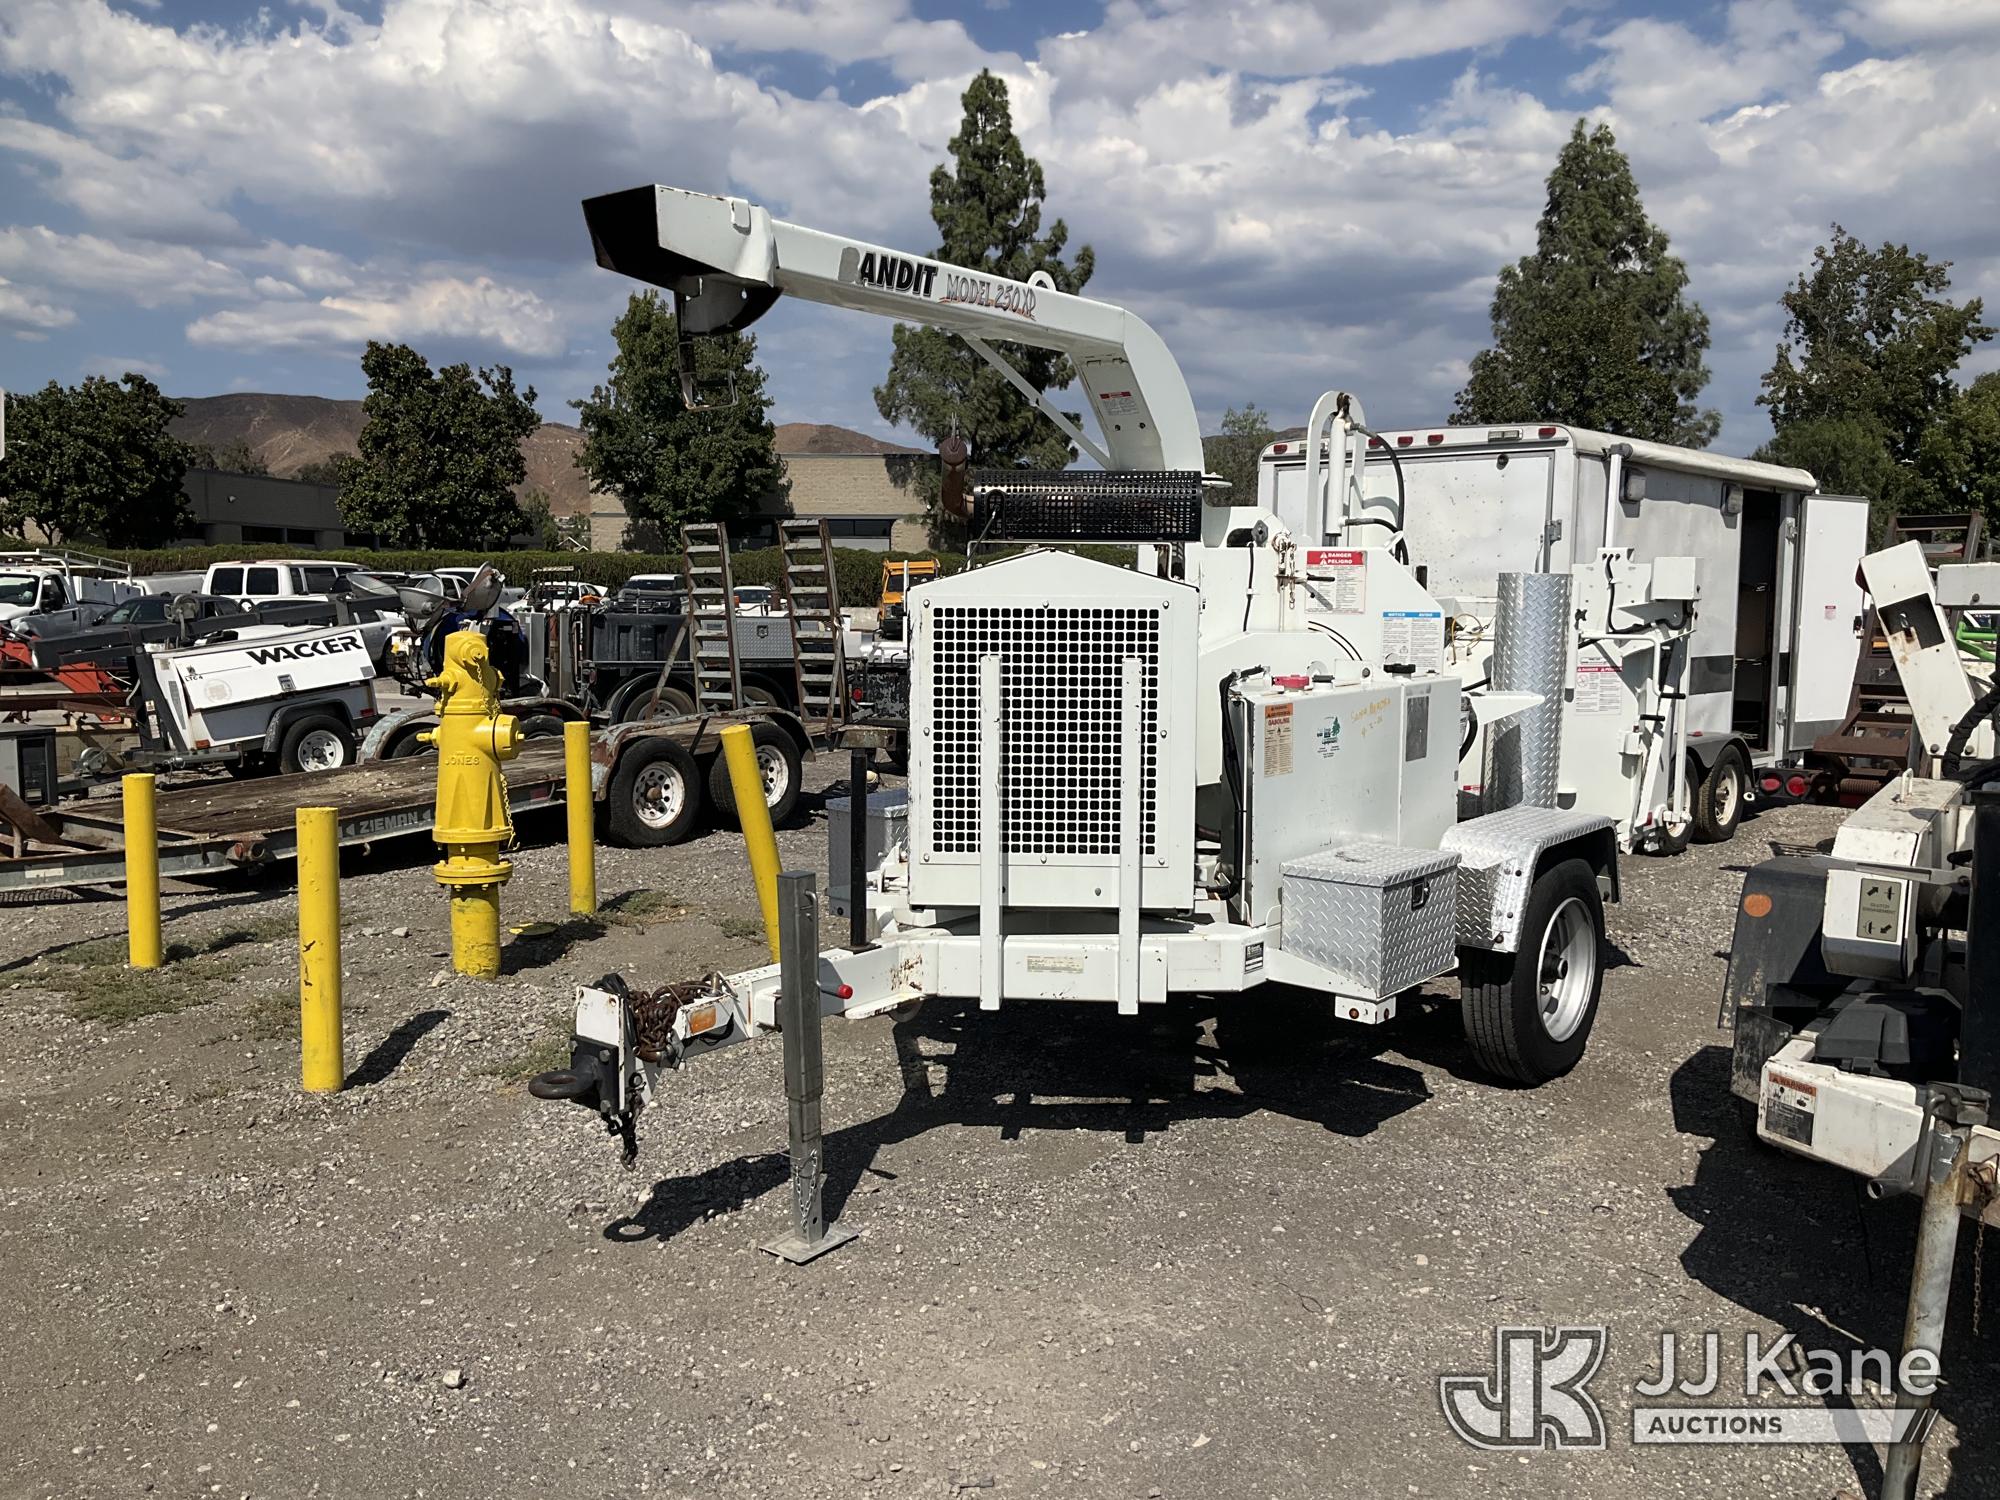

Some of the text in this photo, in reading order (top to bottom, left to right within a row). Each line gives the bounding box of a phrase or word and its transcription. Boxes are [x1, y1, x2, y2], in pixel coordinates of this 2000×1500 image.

[947, 273, 992, 307] MODEL
[245, 635, 363, 665] WACKER
[444, 755, 481, 766] JONES
[360, 811, 419, 834] ZIEMAN
